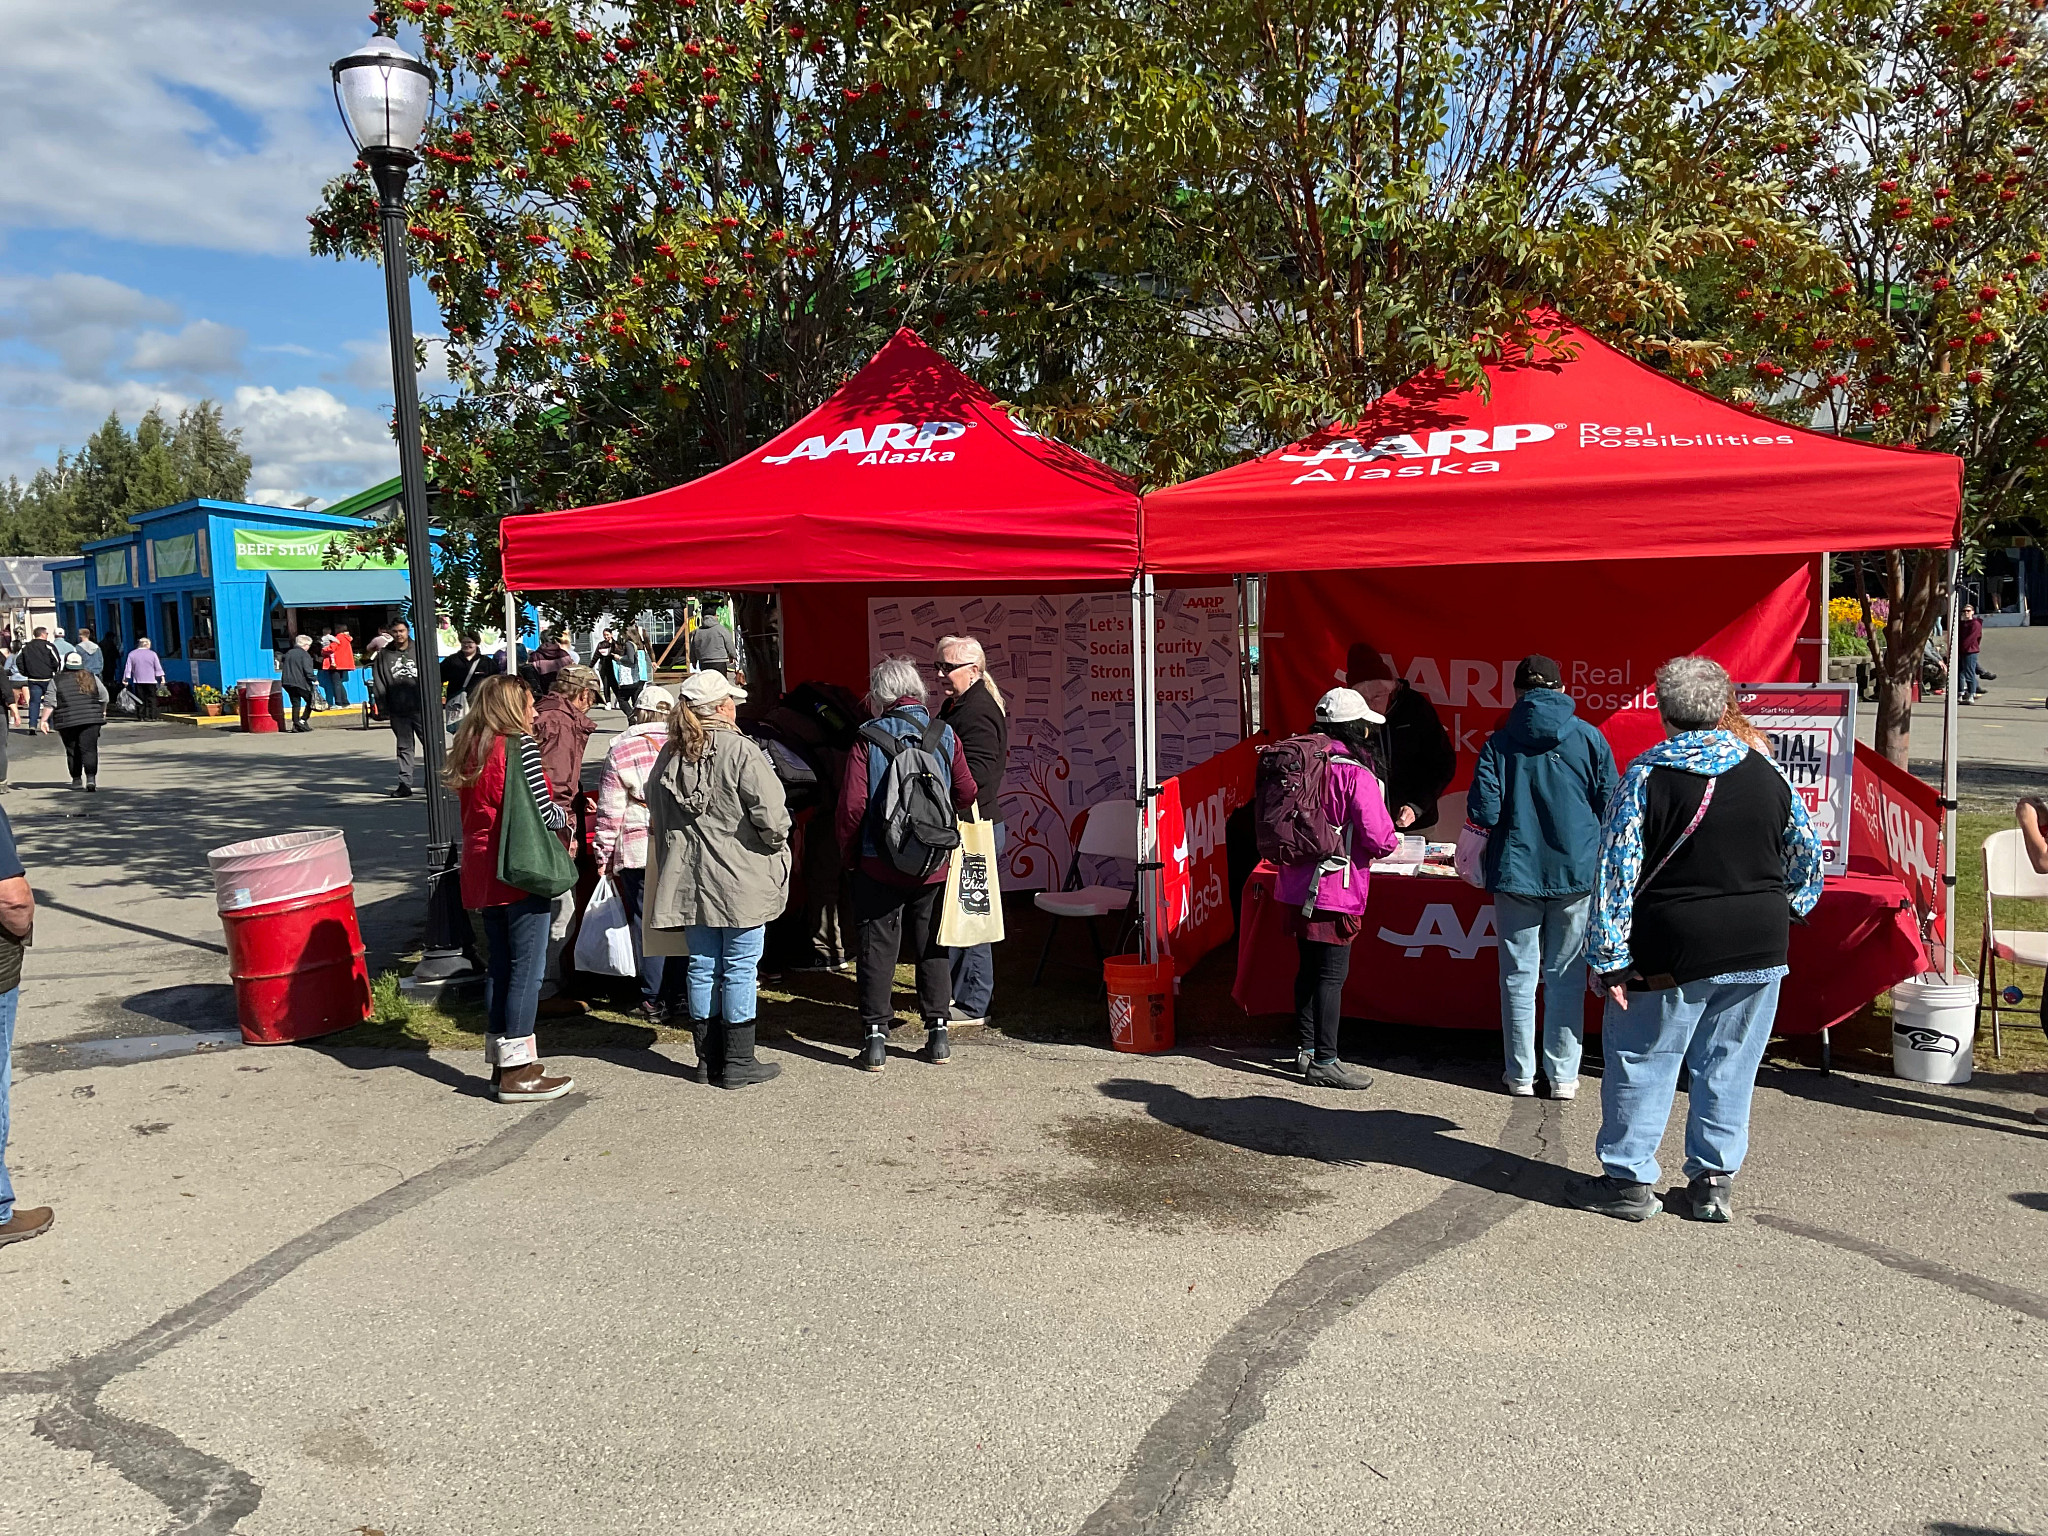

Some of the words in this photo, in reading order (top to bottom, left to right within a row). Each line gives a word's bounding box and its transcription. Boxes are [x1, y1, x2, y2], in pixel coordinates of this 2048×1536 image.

[1579, 422, 1653, 436] Real
[761, 421, 967, 466] AARP
[1279, 424, 1556, 466] AARP
[1579, 434, 1794, 448] Possibilities
[857, 449, 956, 466] Alaska
[1290, 458, 1500, 485] Alaska
[237, 544, 275, 556] BEEF
[278, 544, 319, 556] STEW
[1183, 596, 1225, 609] AARP
[1140, 638, 1203, 657] Scurity
[1090, 664, 1134, 679] Stron
[1169, 662, 1186, 678] th
[1571, 660, 1631, 684] Real
[1091, 689, 1124, 702] next
[1154, 686, 1195, 702] ears!
[1760, 706, 1777, 714] Start
[1767, 734, 1821, 762] CIAL
[1824, 851, 1831, 860] 3
[1377, 903, 1499, 960] AA
